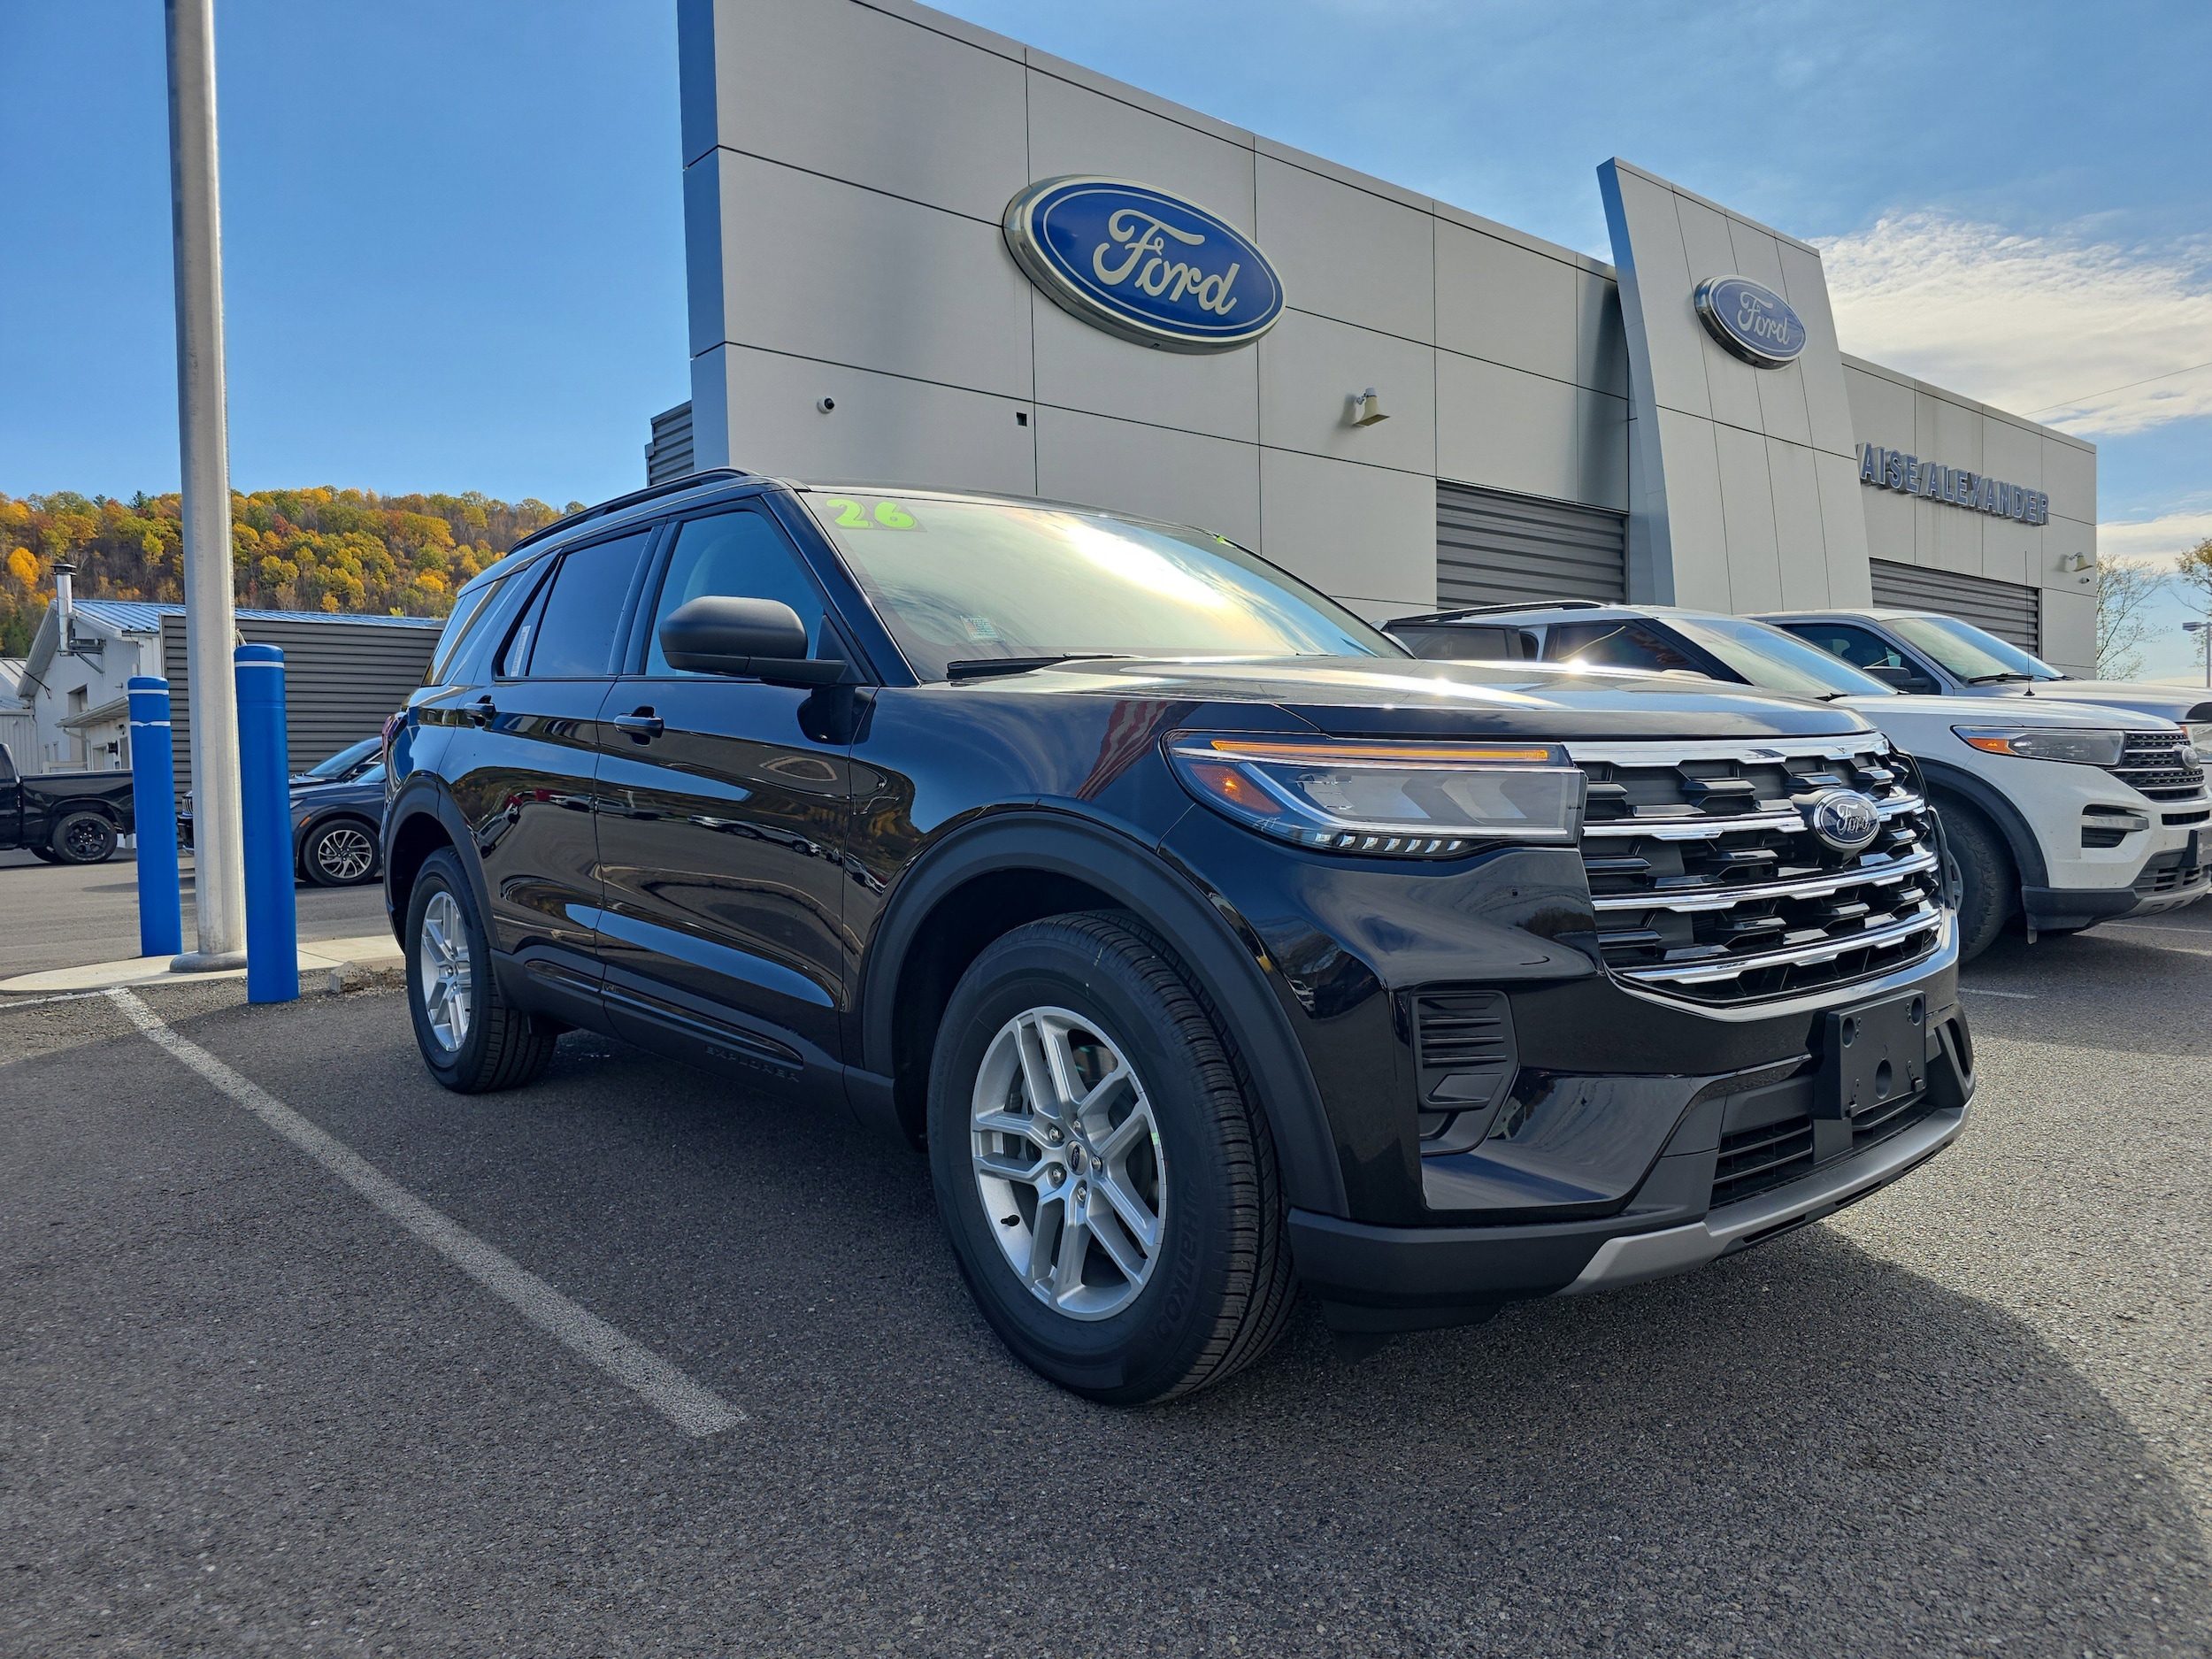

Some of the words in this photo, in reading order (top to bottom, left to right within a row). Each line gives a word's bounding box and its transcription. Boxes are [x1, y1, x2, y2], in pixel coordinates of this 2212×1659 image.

[1093, 209, 1240, 316] Ford
[1737, 291, 1790, 345] Ford
[1856, 442, 1918, 494] AISE
[1922, 461, 2049, 526] ALEXANDER
[826, 498, 918, 529] 26
[1836, 803, 1871, 835] Ford
